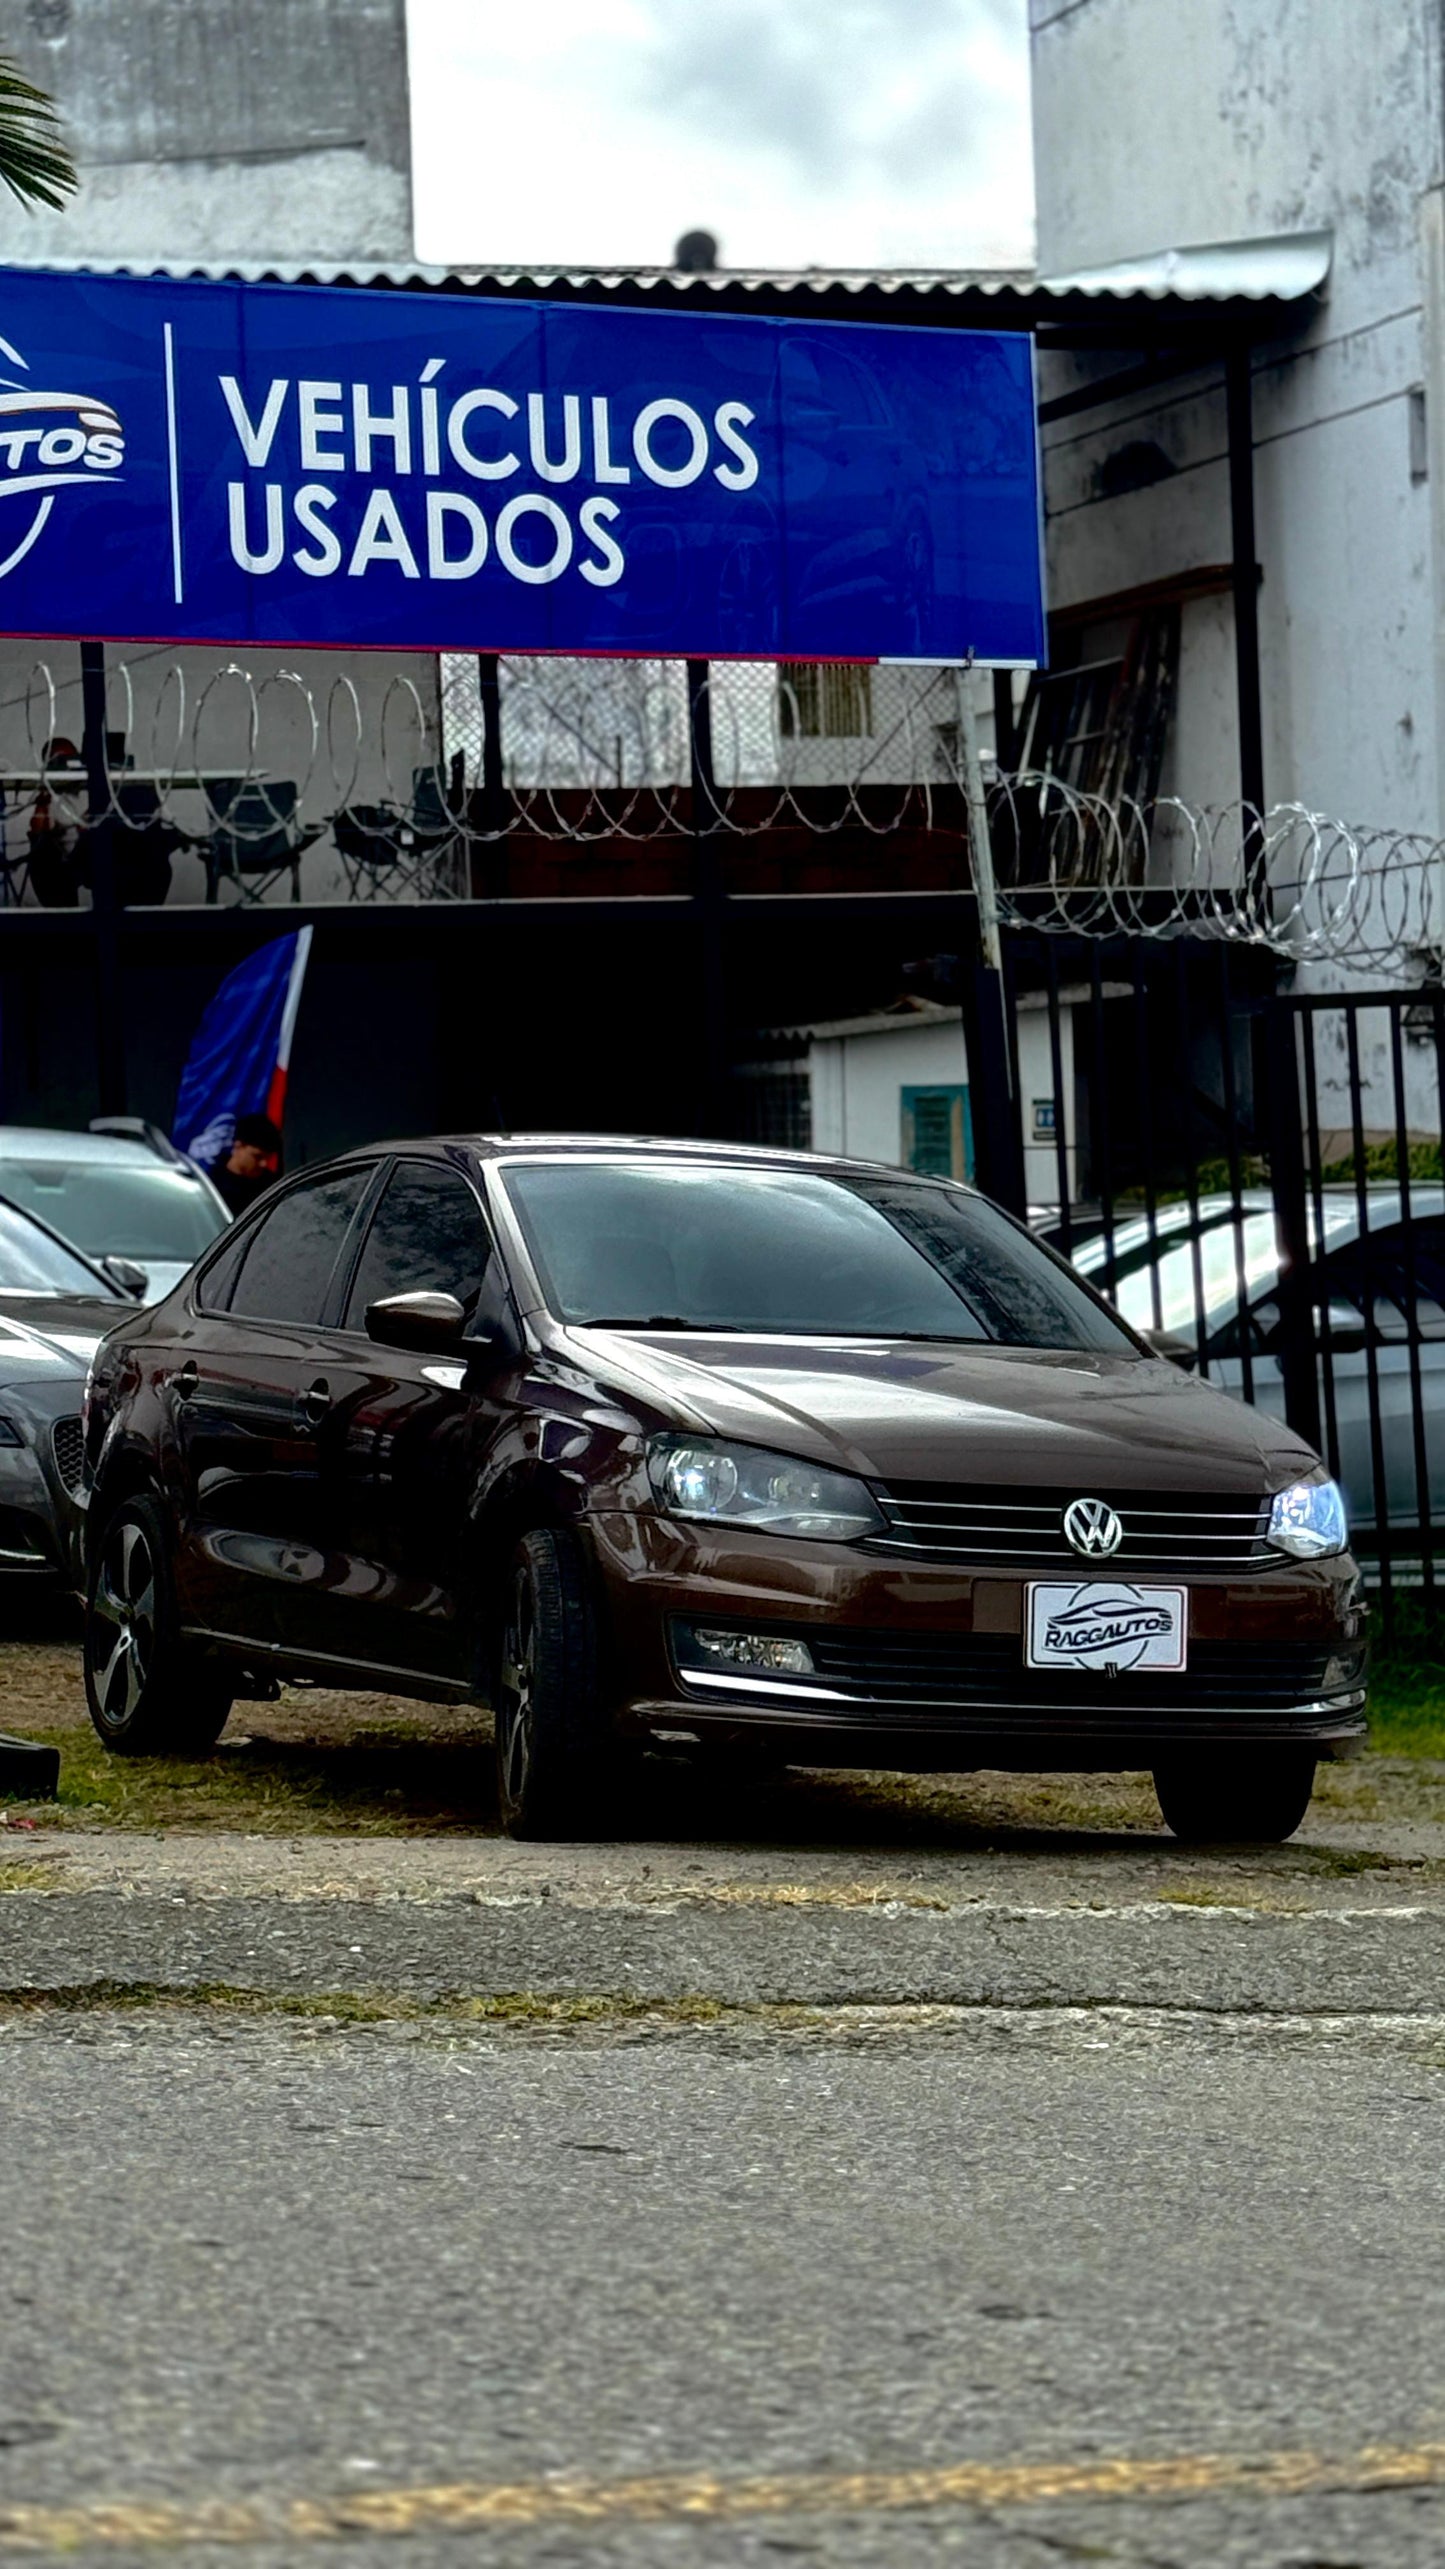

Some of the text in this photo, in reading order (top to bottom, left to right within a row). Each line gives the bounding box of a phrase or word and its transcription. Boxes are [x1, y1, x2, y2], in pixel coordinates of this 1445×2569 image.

[218, 358, 759, 491] VEHÍCULOS
[228, 482, 625, 587] USADOS
[1044, 1618, 1173, 1648] RAGGAUTOS
